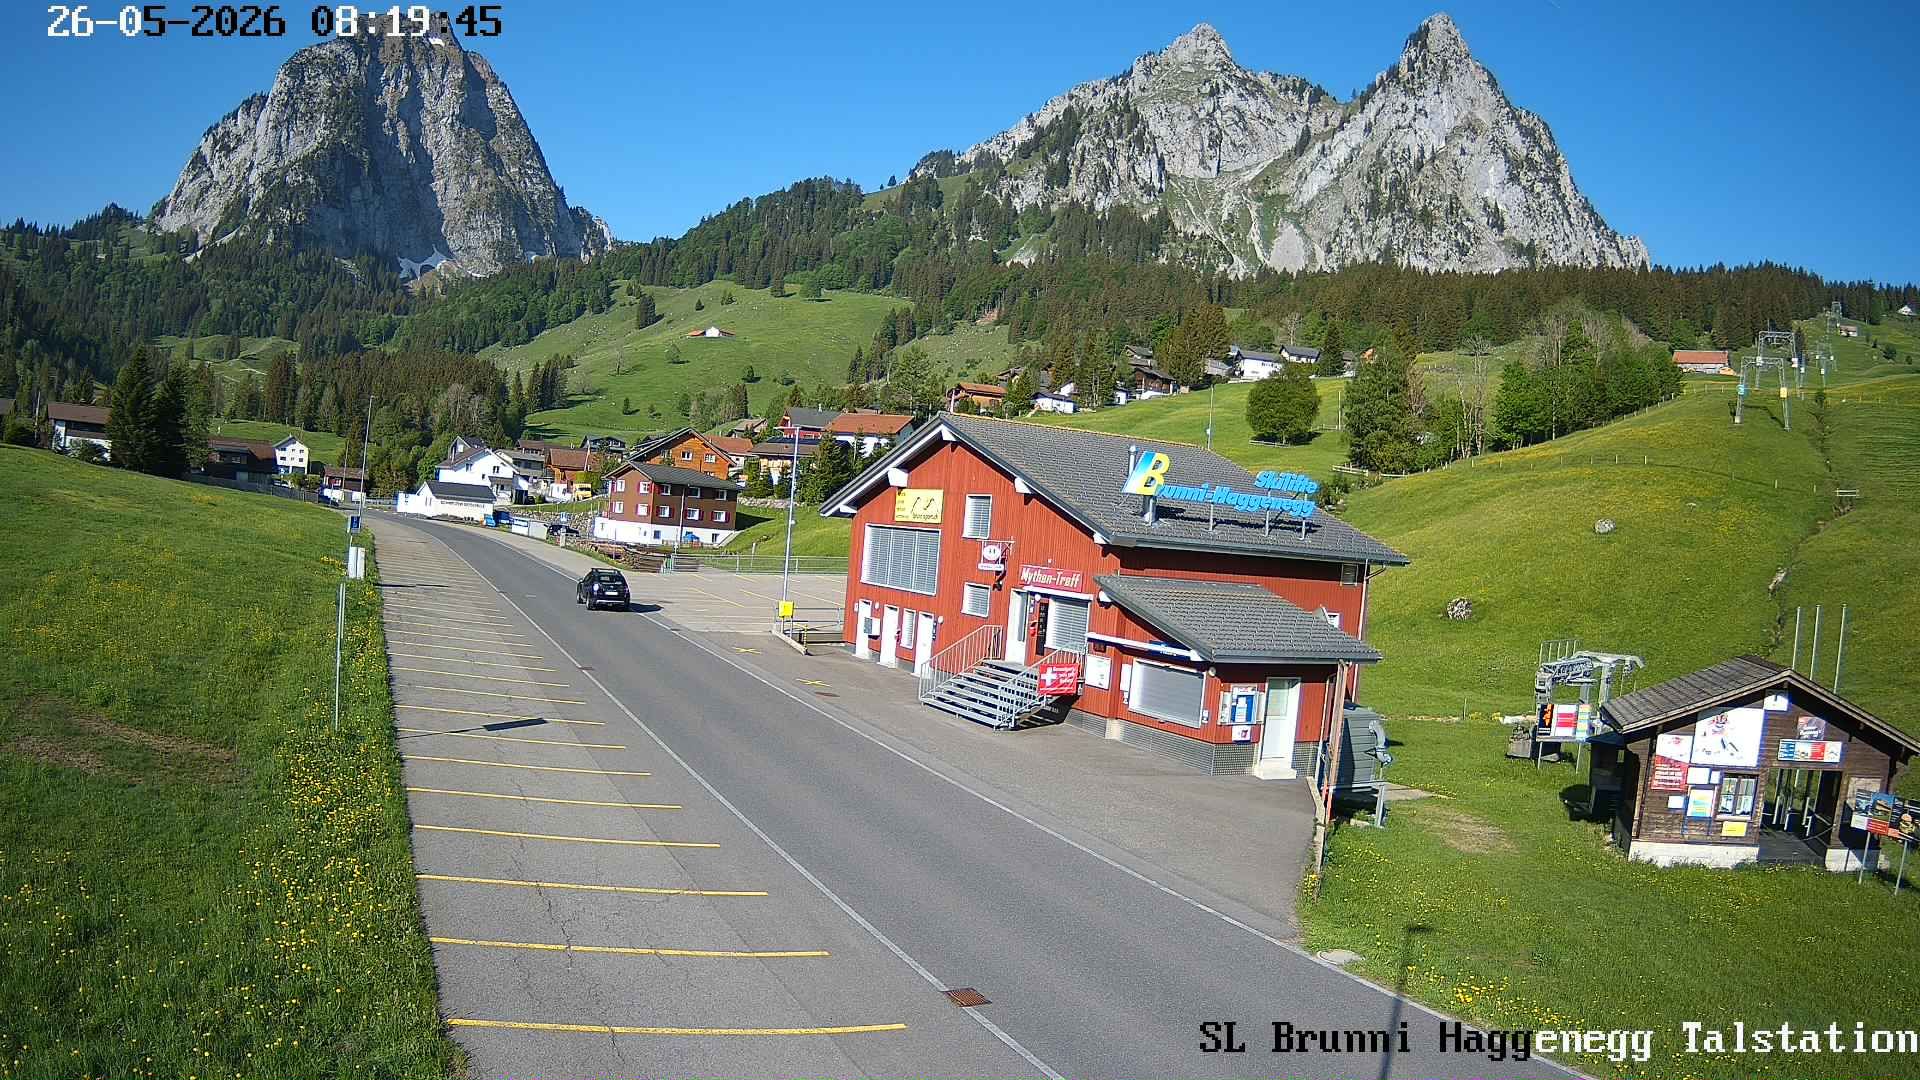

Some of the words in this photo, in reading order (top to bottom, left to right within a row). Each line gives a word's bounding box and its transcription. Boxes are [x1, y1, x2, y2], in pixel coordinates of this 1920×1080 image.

[1121, 450, 1317, 518] Brunni-Haggenegg
[1254, 470, 1319, 494] Skilifte
[1020, 567, 1081, 588] Mythen-Treff
